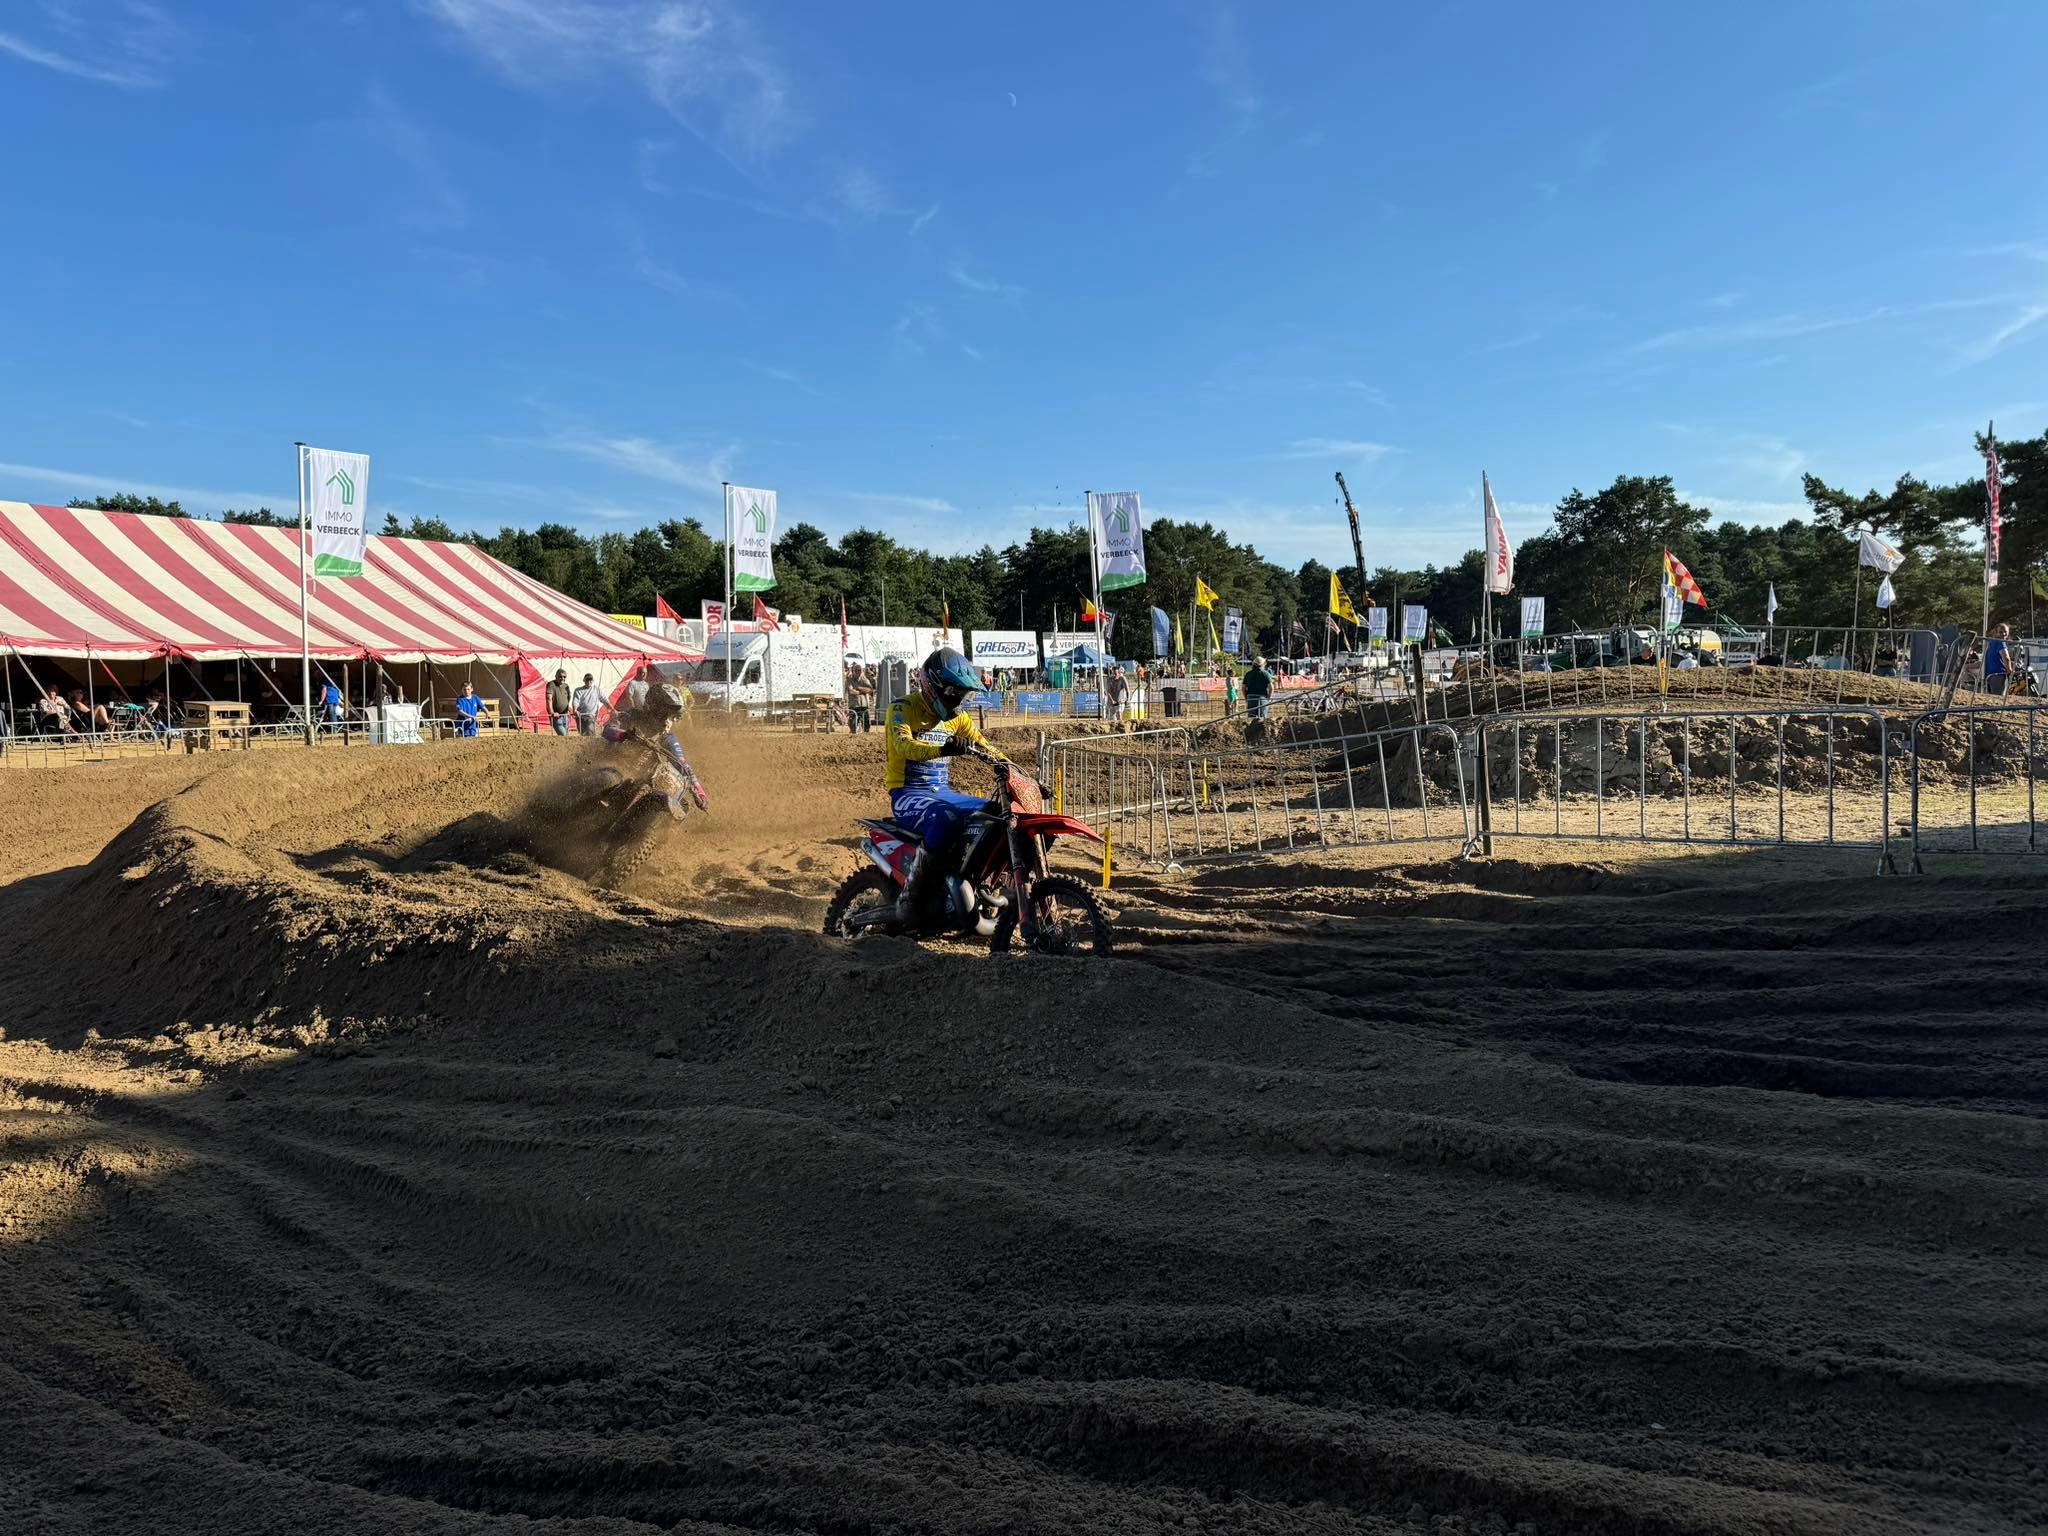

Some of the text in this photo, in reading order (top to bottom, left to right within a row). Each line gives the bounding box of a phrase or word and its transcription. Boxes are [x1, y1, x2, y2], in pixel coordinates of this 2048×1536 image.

[325, 511, 353, 522] IMMO
[317, 525, 360, 536] VERBEECK
[743, 538, 766, 548] MMO
[1108, 538, 1131, 547] MMO
[919, 733, 948, 743] STROEC
[894, 795, 935, 811] UFO
